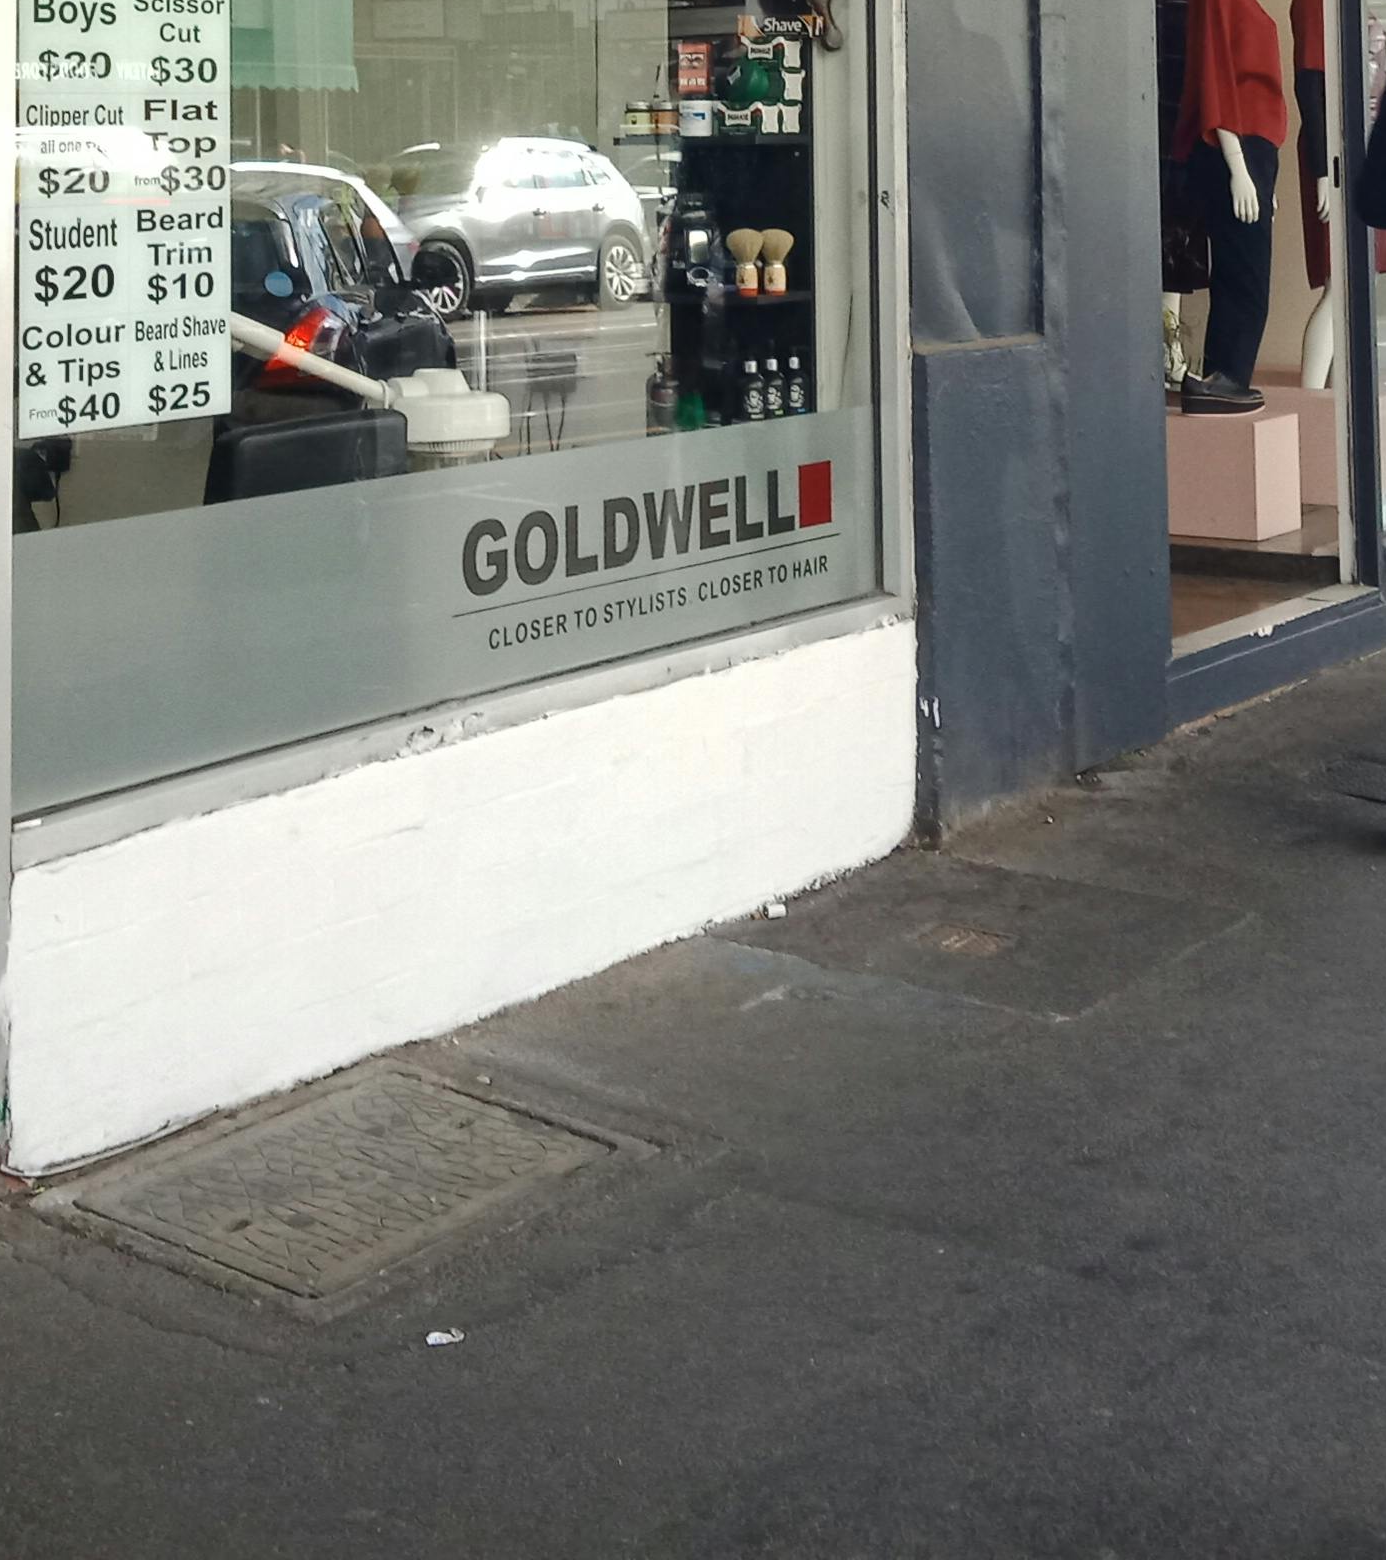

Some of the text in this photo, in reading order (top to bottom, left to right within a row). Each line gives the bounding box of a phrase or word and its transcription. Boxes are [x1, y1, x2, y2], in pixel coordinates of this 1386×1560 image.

[159, 22, 201, 43] Cut
[763, 17, 803, 35] Shave
[151, 56, 218, 86] $30
[26, 104, 124, 127] Clipper Cut
[144, 99, 218, 121] Flat
[40, 139, 55, 154] all
[59, 139, 81, 153] one
[143, 132, 217, 158] Top
[38, 166, 110, 198] $20
[134, 165, 226, 196] from $30
[137, 206, 223, 232] Beard
[29, 217, 118, 251] Student
[147, 242, 212, 266] Trim
[34, 264, 115, 307] $20
[147, 272, 214, 305] $10
[22, 323, 125, 350] Colour
[135, 315, 226, 342] Beard Shave
[26, 358, 121, 387] & Tips
[154, 348, 208, 372] & Lines
[29, 392, 120, 428] From $40
[148, 381, 211, 416] $25
[462, 469, 796, 596] GOLDWELL
[488, 614, 568, 650] CLOSER
[573, 607, 598, 630] TO
[699, 566, 763, 601] CLOSER
[767, 564, 788, 585] TO
[792, 554, 829, 579] HAIR
